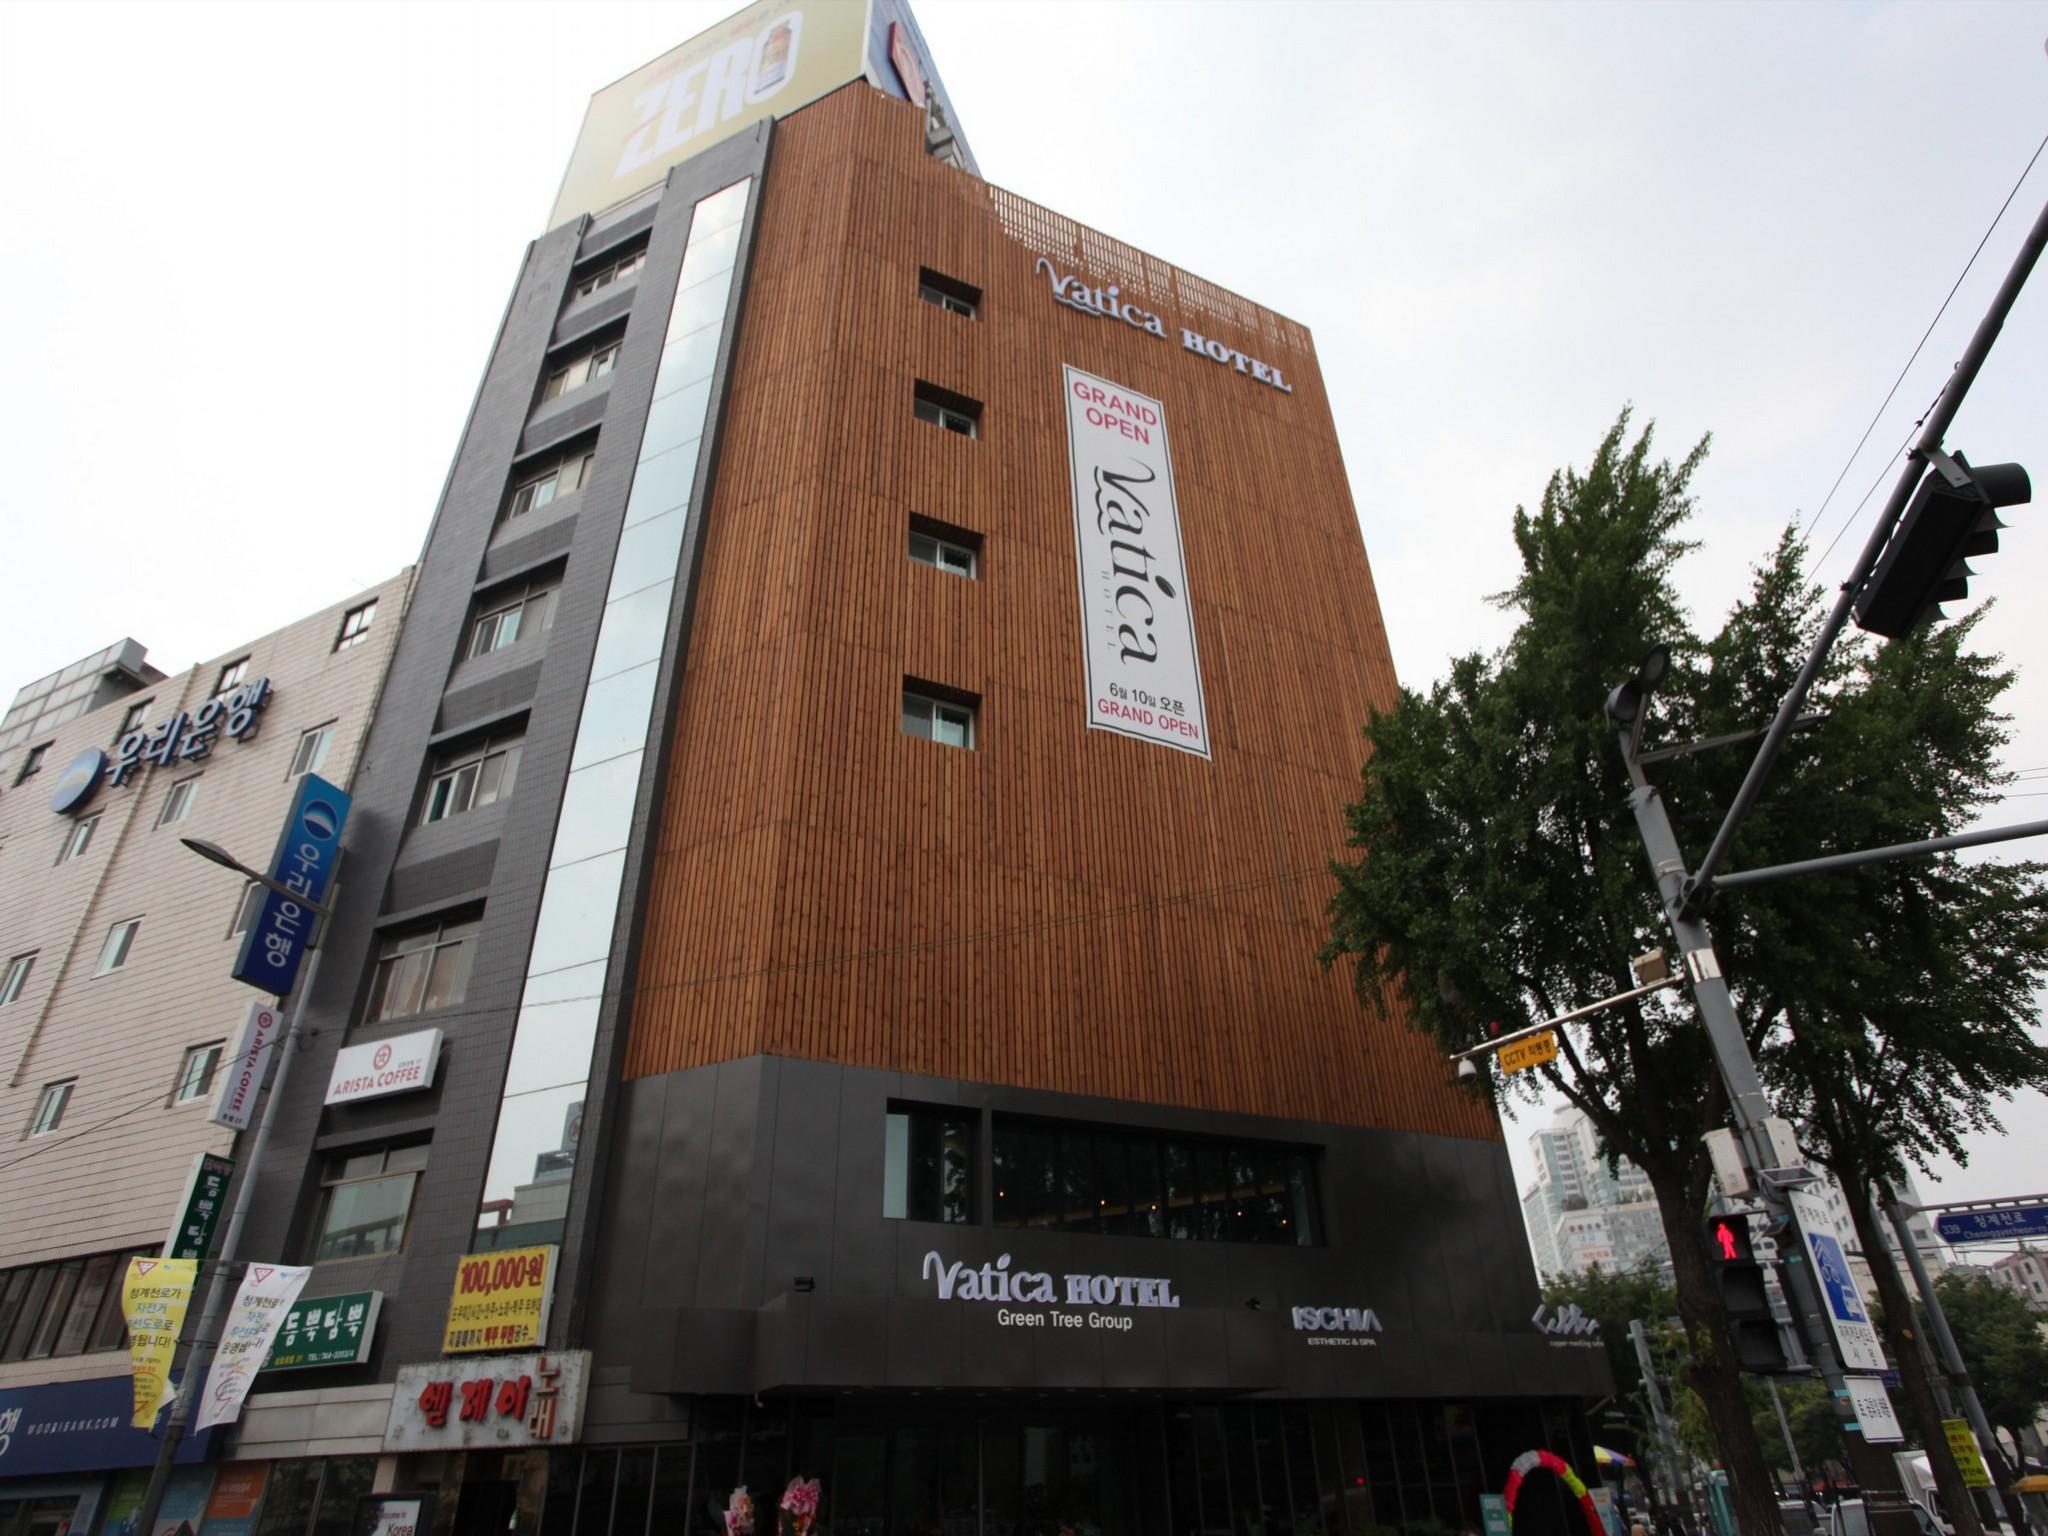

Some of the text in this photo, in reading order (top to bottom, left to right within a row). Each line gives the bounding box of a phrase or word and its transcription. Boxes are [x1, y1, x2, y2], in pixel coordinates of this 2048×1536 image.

[613, 10, 803, 180] ZERO
[1036, 257, 1293, 394] Vatica HOTEL
[1073, 381, 1157, 426] GRAND
[1086, 407, 1150, 446] OPEN
[1096, 456, 1176, 665] Vatica
[1100, 569, 1116, 651] HOTEL
[1097, 698, 1200, 740] GRAND OPEN
[1109, 682, 1186, 717] 6월 10일 오픈
[105, 676, 271, 788] 우리은행
[265, 843, 321, 968] 우리은행
[245, 1029, 265, 1069] ARISTA
[1504, 1048, 1526, 1066] CCTV
[230, 1070, 253, 1112] COFFEE
[333, 1066, 421, 1096] ARISTA COFFEE
[1973, 1211, 2027, 1229] 청계천로
[129, 1288, 181, 1299] 청계천로가
[460, 1254, 545, 1296] 100,000원
[922, 1250, 1180, 1308] Vatica HOTEL
[997, 1309, 1133, 1332] Green Tree Group
[1352, 1338, 1359, 1346] &
[1359, 1338, 1377, 1346] SPA
